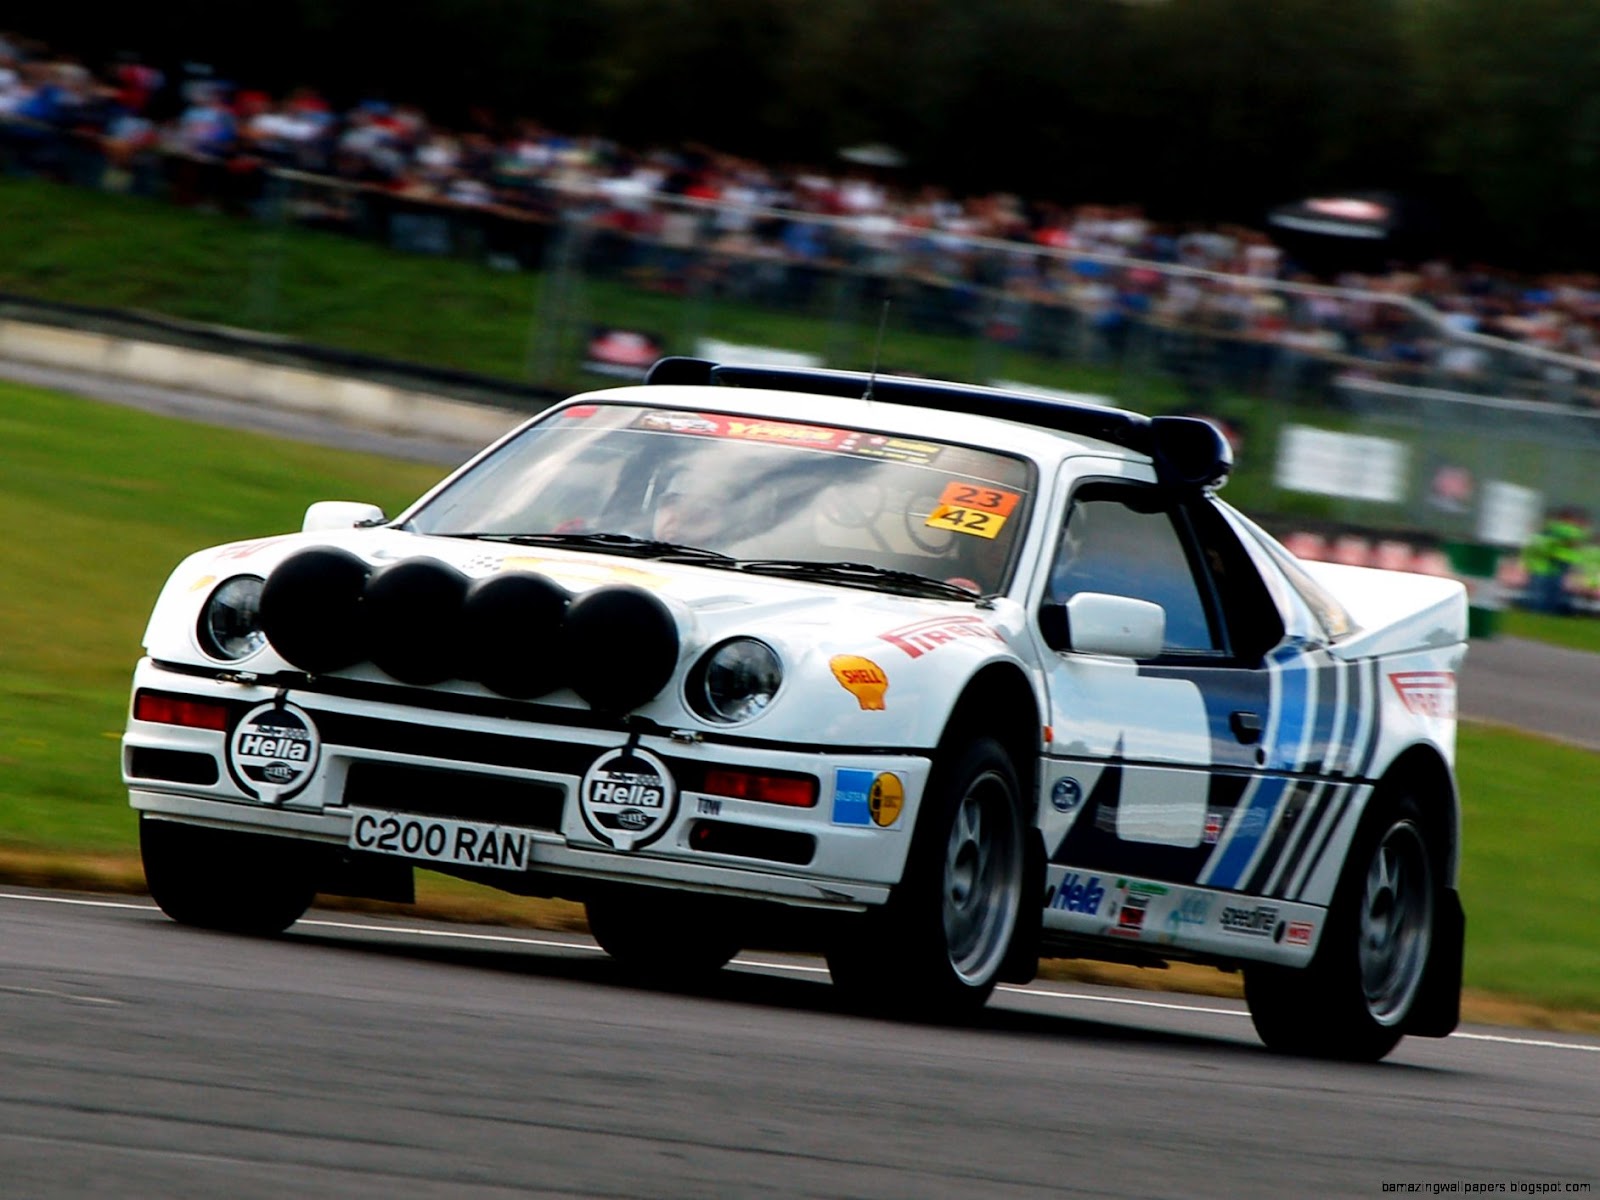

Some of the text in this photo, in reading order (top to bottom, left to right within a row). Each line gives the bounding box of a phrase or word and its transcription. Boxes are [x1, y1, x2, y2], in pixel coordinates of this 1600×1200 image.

[954, 487, 1002, 508] 23
[940, 509, 990, 531] 42
[841, 668, 882, 684] SHELL
[241, 735, 307, 760] Hella
[592, 782, 661, 807] Hella
[355, 815, 526, 868] C200 RAN
[1052, 873, 1105, 915] Hella
